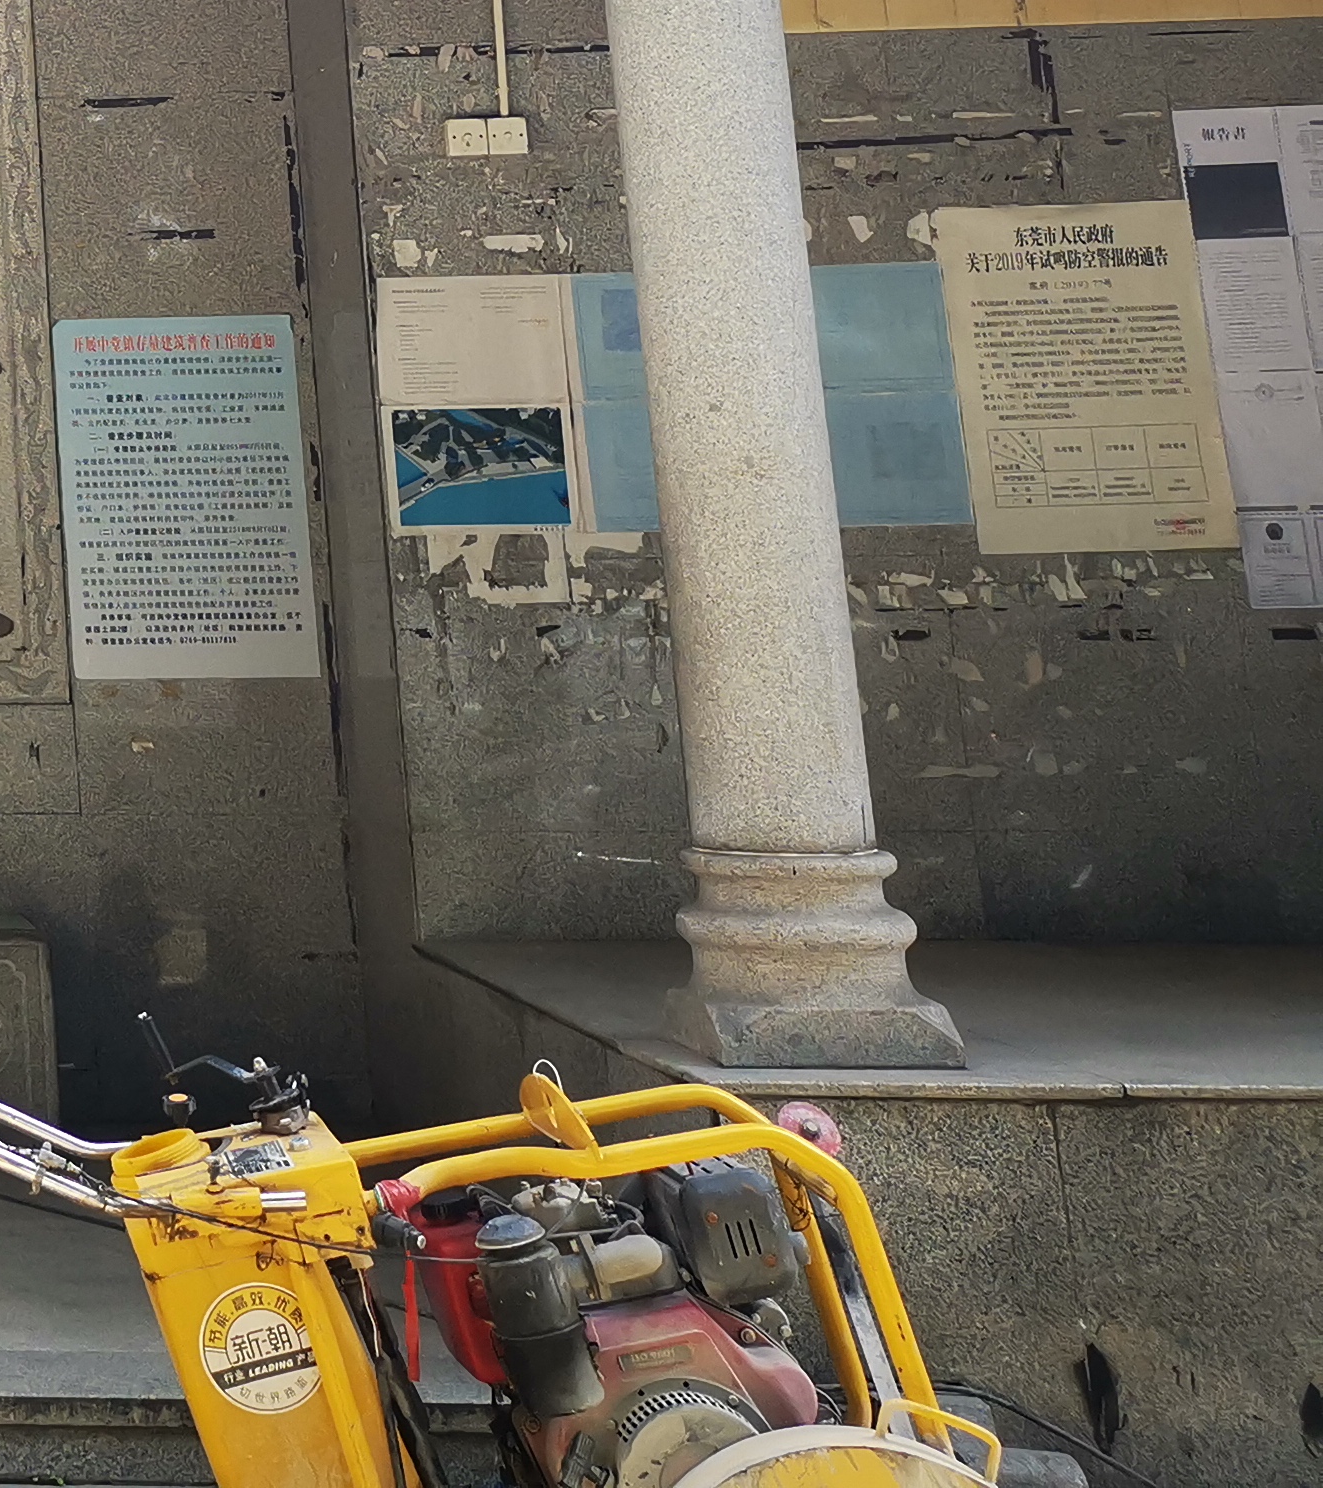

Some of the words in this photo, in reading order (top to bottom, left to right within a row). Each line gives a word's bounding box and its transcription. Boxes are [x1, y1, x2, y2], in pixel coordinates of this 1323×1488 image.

[1014, 223, 1115, 248] 东莞市人民政府
[966, 245, 1169, 274] 关于2019年试鸣防空警报的通告
[248, 1358, 294, 1378] LEADING
